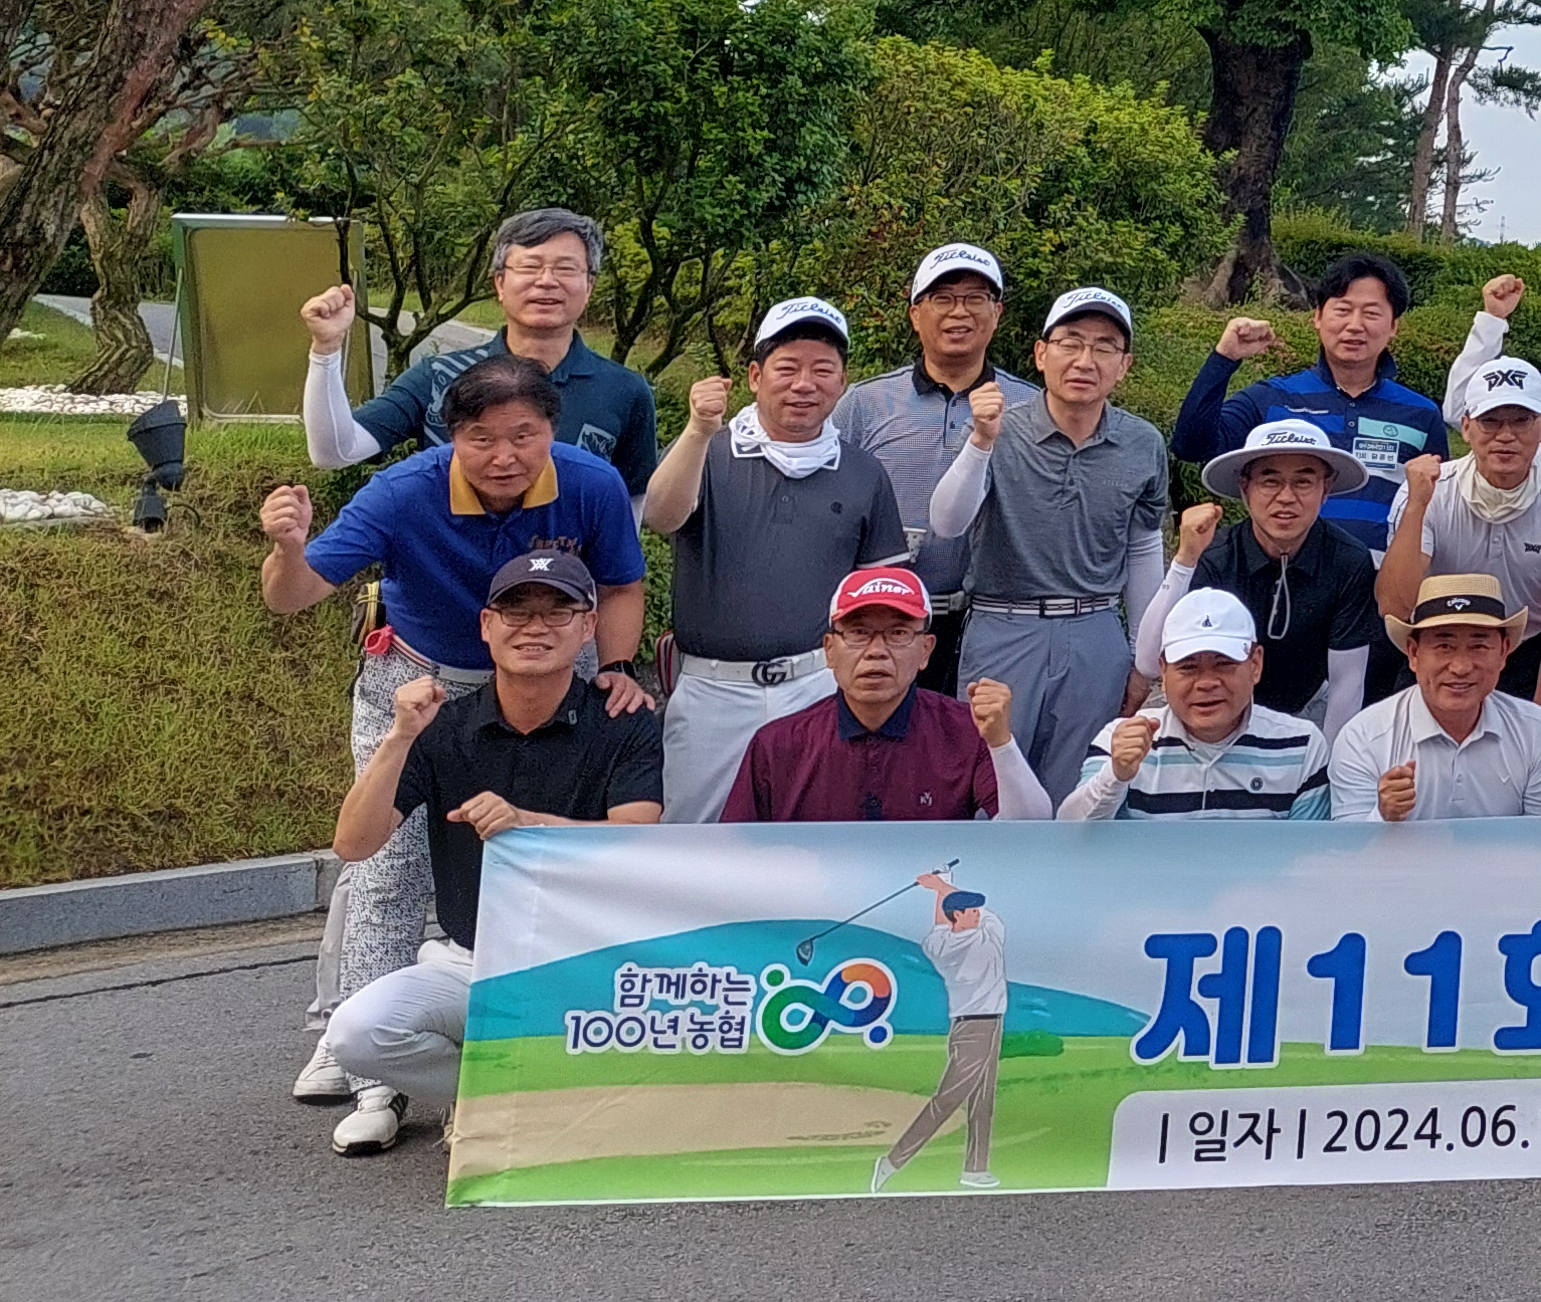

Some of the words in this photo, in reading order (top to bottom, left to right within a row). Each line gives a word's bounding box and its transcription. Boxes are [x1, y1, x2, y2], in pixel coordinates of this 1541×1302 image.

[776, 301, 843, 324] Titleist
[1483, 369, 1529, 392] PXG
[1261, 431, 1319, 447] Titleist
[619, 967, 752, 1009] 함께하는
